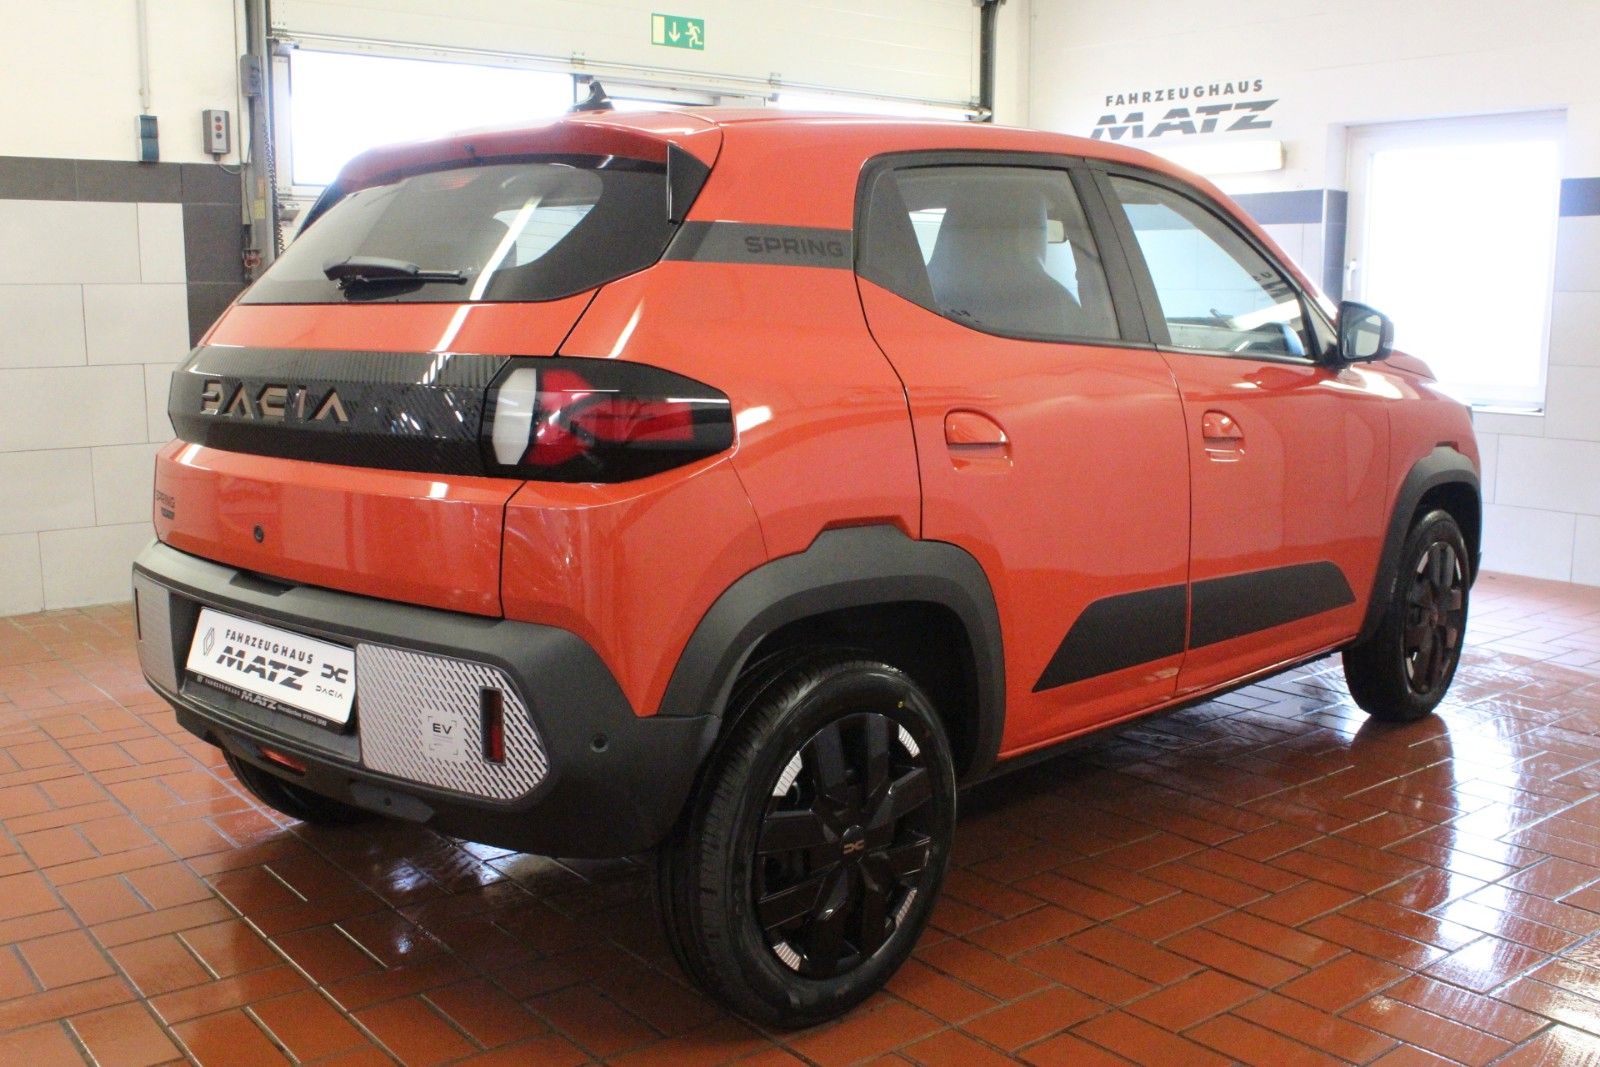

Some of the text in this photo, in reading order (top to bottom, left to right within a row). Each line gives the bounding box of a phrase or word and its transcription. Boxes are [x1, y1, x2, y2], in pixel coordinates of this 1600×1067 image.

[1105, 79, 1263, 107] FAHRZEUGHAUS
[1090, 99, 1279, 140] MATZ
[744, 236, 844, 257] SPRING
[200, 379, 348, 422] DACIA
[225, 629, 314, 665] FAHRZEUGHAUS
[216, 645, 309, 691] MATZ
[241, 690, 277, 710] MATZ
[315, 684, 344, 700] DACIA
[432, 722, 452, 735] EV
